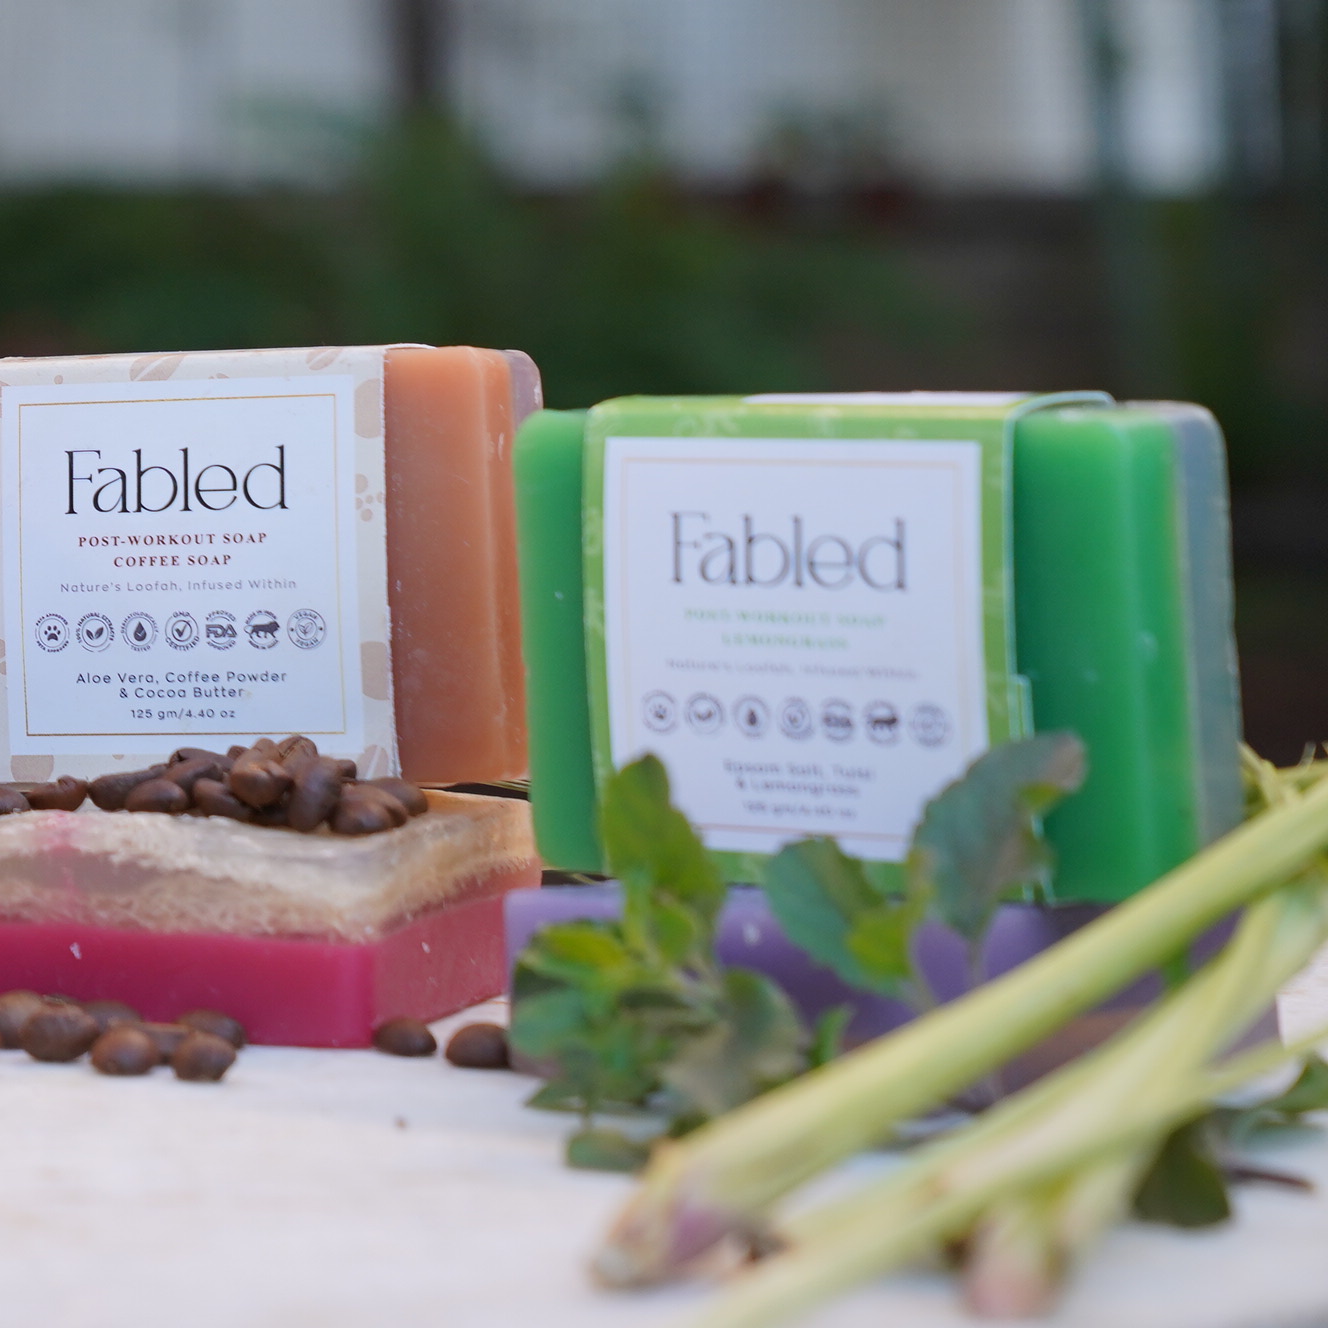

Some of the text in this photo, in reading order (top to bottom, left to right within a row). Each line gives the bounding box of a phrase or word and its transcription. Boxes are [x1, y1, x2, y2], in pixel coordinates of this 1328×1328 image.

[65, 445, 288, 514] Fabled
[79, 533, 266, 547] POST-WORKOUT SOAP
[668, 510, 908, 592] Fabled
[114, 555, 231, 567] COFFEE SOAP
[61, 579, 296, 592] Nature's Loofah, Infused Within
[205, 624, 238, 639] FDA
[77, 671, 286, 684] Aloe Vera, Coffee Powder
[120, 686, 244, 698] & Cocoa Butter
[131, 708, 235, 720] 125 gm/4.40 oz
